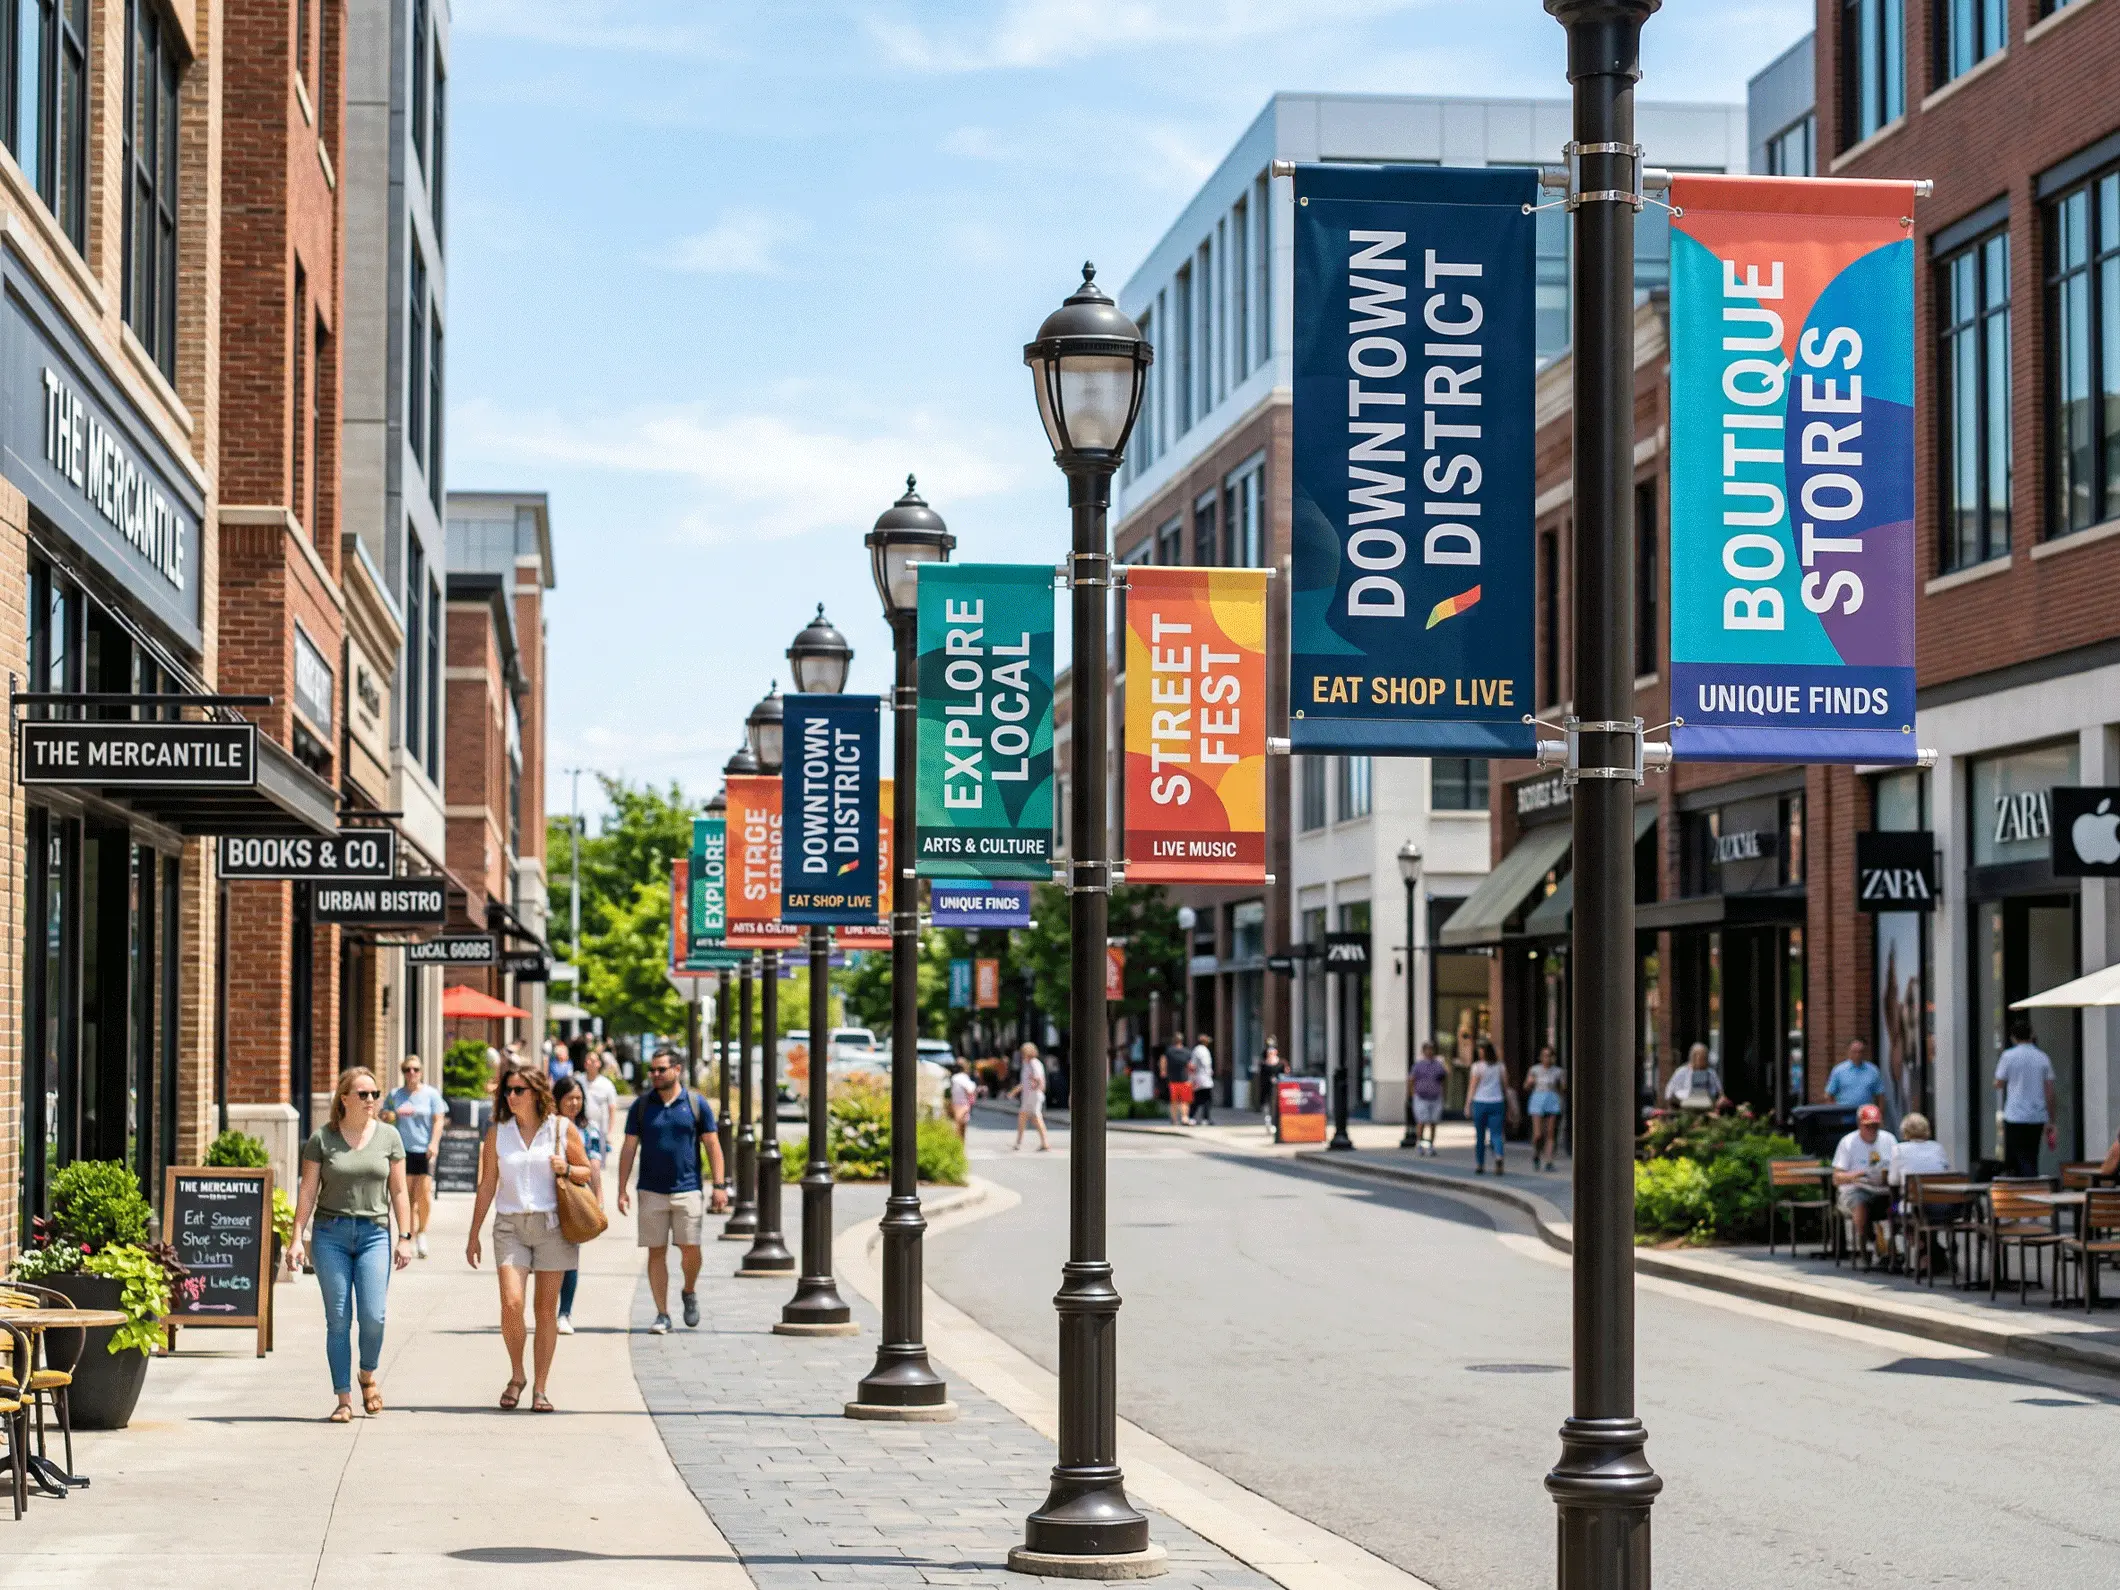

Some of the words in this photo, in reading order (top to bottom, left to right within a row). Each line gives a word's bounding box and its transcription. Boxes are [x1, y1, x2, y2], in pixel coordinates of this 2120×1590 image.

[1348, 230, 1407, 617] DOWNTOWN
[1424, 249, 1483, 566] DISTRICT
[1722, 259, 1791, 631] BOUTIQUE
[1800, 326, 1864, 615] STORES
[45, 367, 83, 488] THE
[87, 416, 185, 591] MERCANTILE
[944, 598, 983, 809] EXPLORE
[991, 631, 1030, 781] LOCAL
[1150, 613, 1192, 805] STREET
[1200, 644, 1240, 764] FEST
[1313, 675, 1363, 703] EAT
[1371, 677, 1446, 705] SHOP
[1455, 678, 1515, 706] LIVE
[1700, 684, 1800, 714] UNIQUE
[1810, 685, 1889, 715] FINDS
[33, 741, 80, 766] THE
[88, 742, 242, 767] MERCANTILE
[803, 717, 829, 874] DOWNTOWN
[833, 728, 860, 853] DISTRICT
[1994, 790, 2051, 843] ZARA
[228, 839, 312, 868] BOOKS
[319, 841, 337, 868] &
[345, 840, 386, 869] CO.
[923, 837, 962, 853] ARTS
[965, 838, 977, 853] &
[980, 838, 1045, 854] CULTURE
[1153, 841, 1186, 856] LIVE
[1189, 841, 1237, 857] MUSIC
[318, 891, 376, 912] URBAN
[380, 891, 442, 912] BISTRO
[705, 833, 724, 929] EXPLORE
[789, 894, 810, 907] EAT
[813, 895, 844, 907] SHOP
[847, 895, 872, 908] LIVE
[940, 897, 983, 910] UNIQUE
[986, 897, 1020, 910] FINDS
[1862, 869, 1930, 899] ZARA
[411, 942, 448, 959] LOCAL
[450, 942, 490, 959] GOODS
[180, 1181, 197, 1192] THE
[200, 1182, 259, 1194] MERCANTILE
